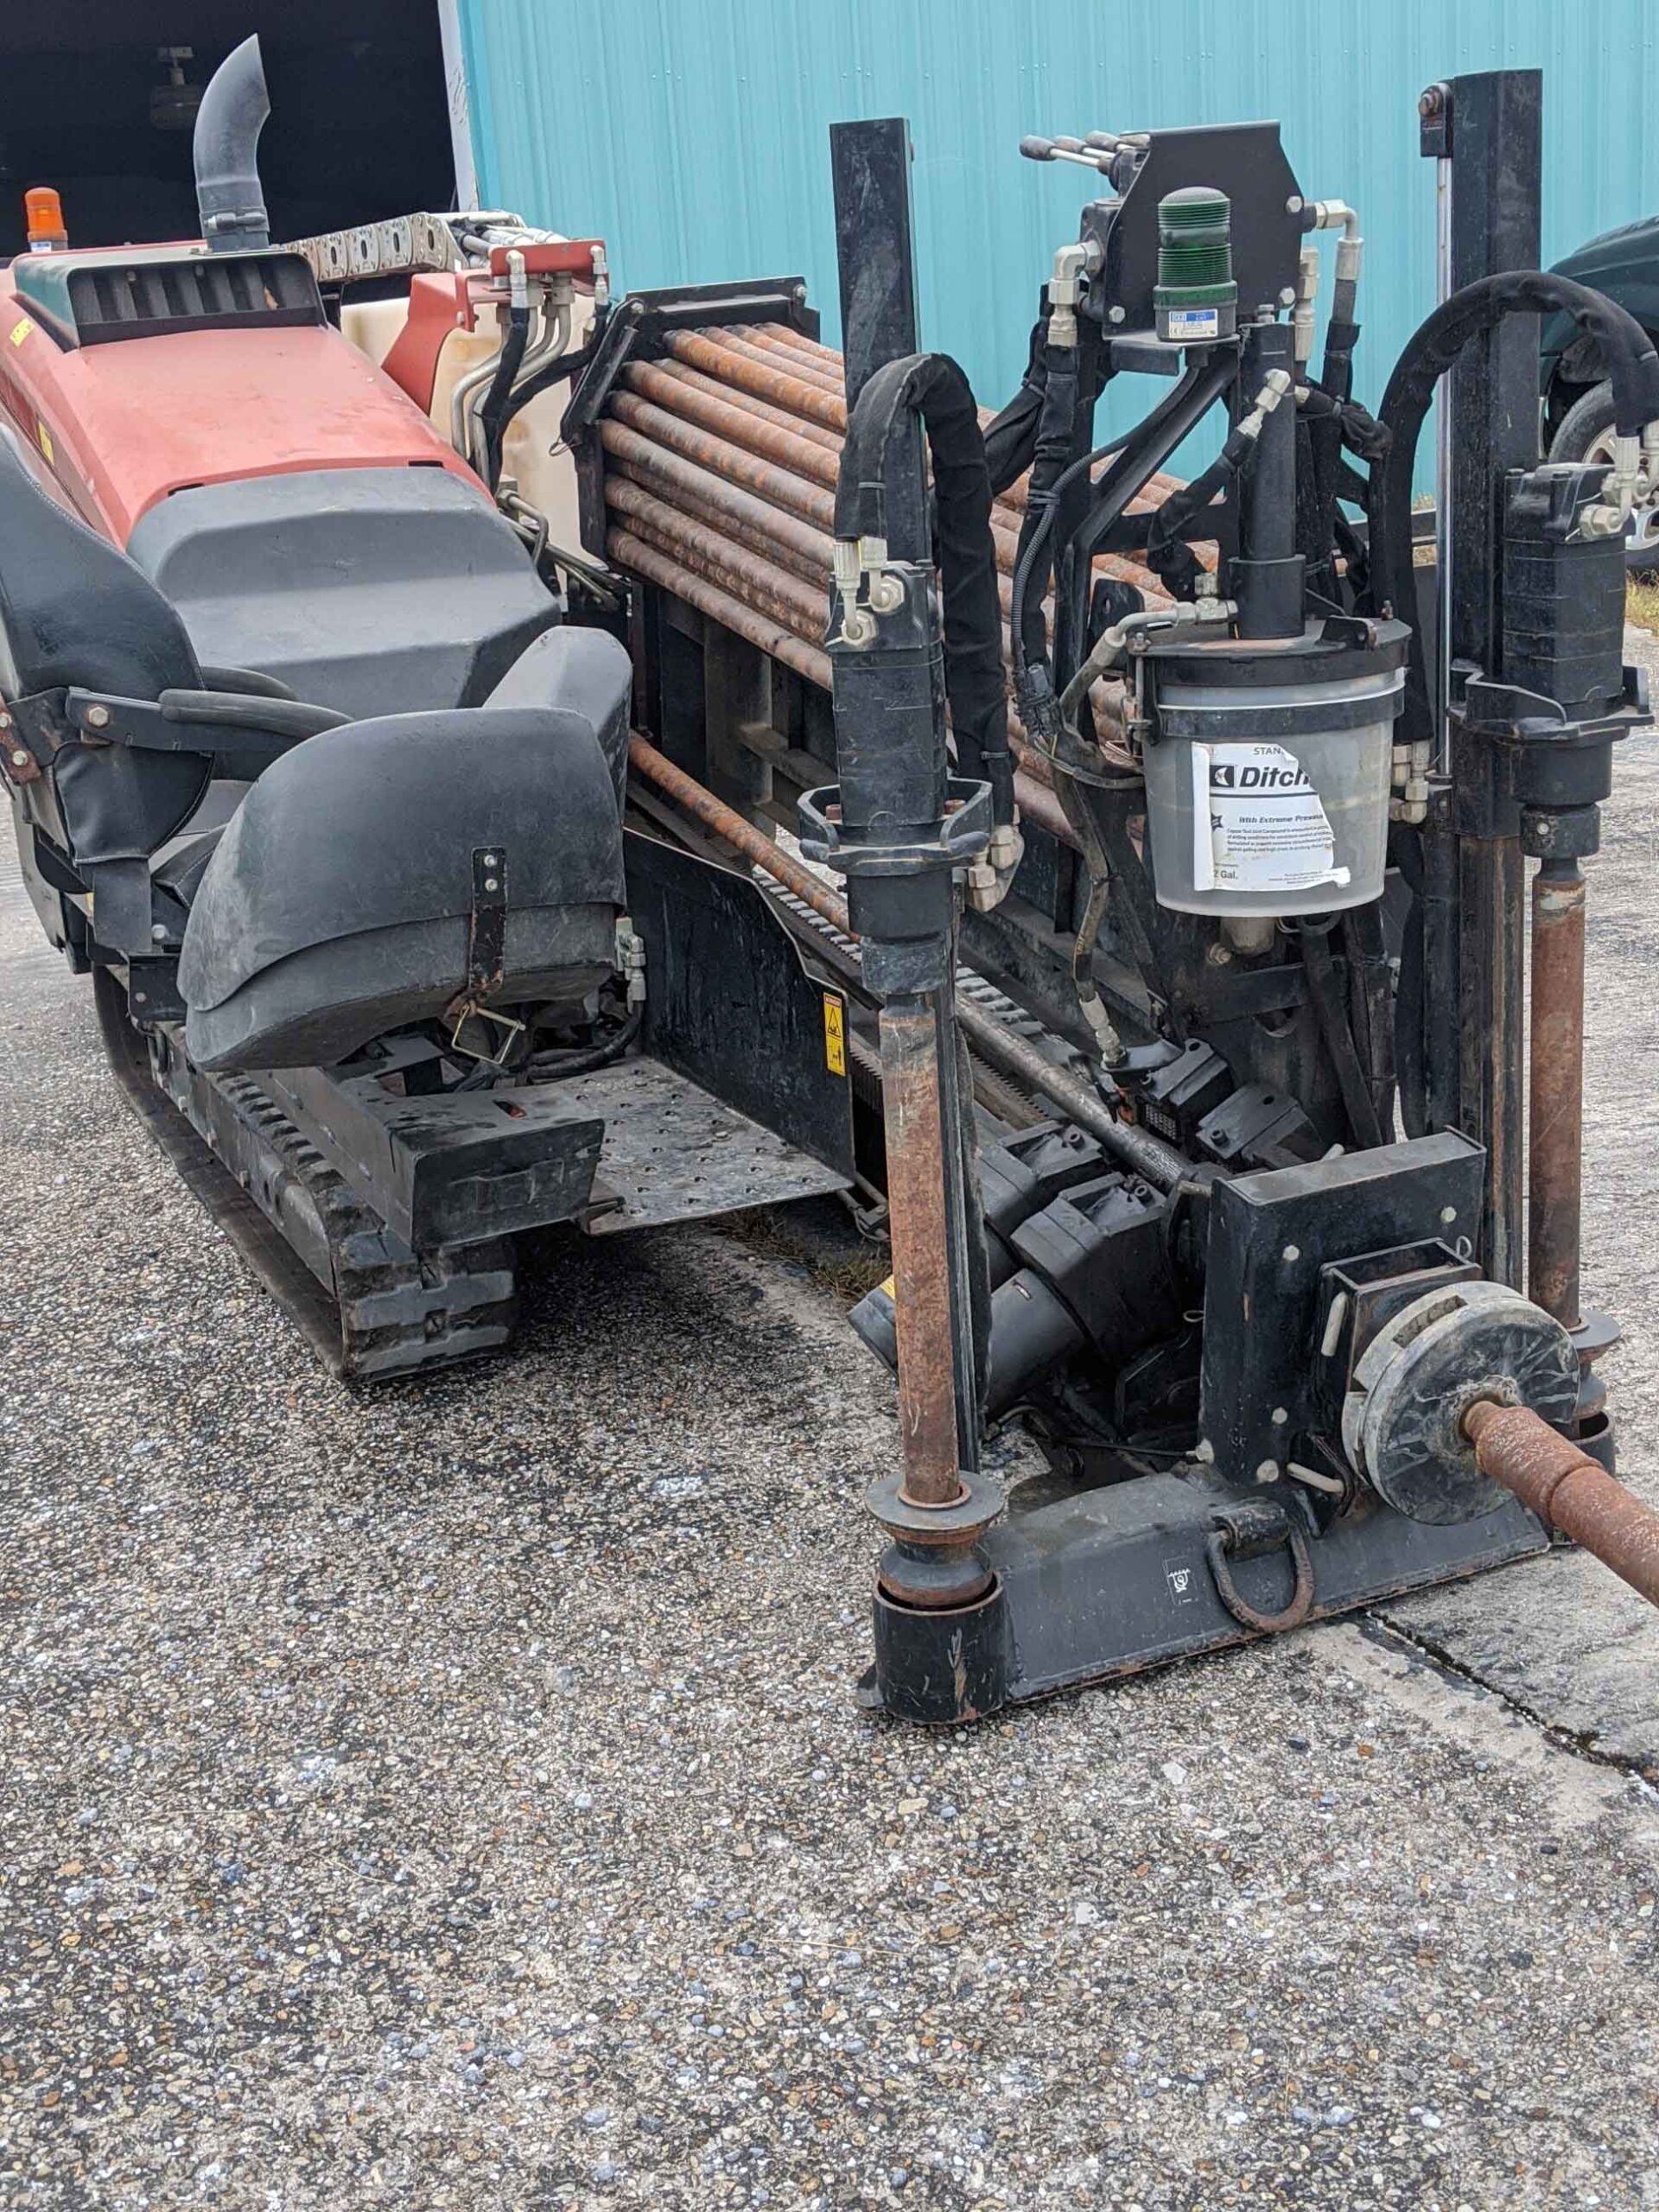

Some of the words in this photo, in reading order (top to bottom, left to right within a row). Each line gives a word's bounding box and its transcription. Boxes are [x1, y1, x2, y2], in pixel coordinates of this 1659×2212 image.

[1253, 747, 1284, 755] STAN
[1239, 766, 1310, 787] Ditch
[1220, 868, 1239, 880] Gal.
